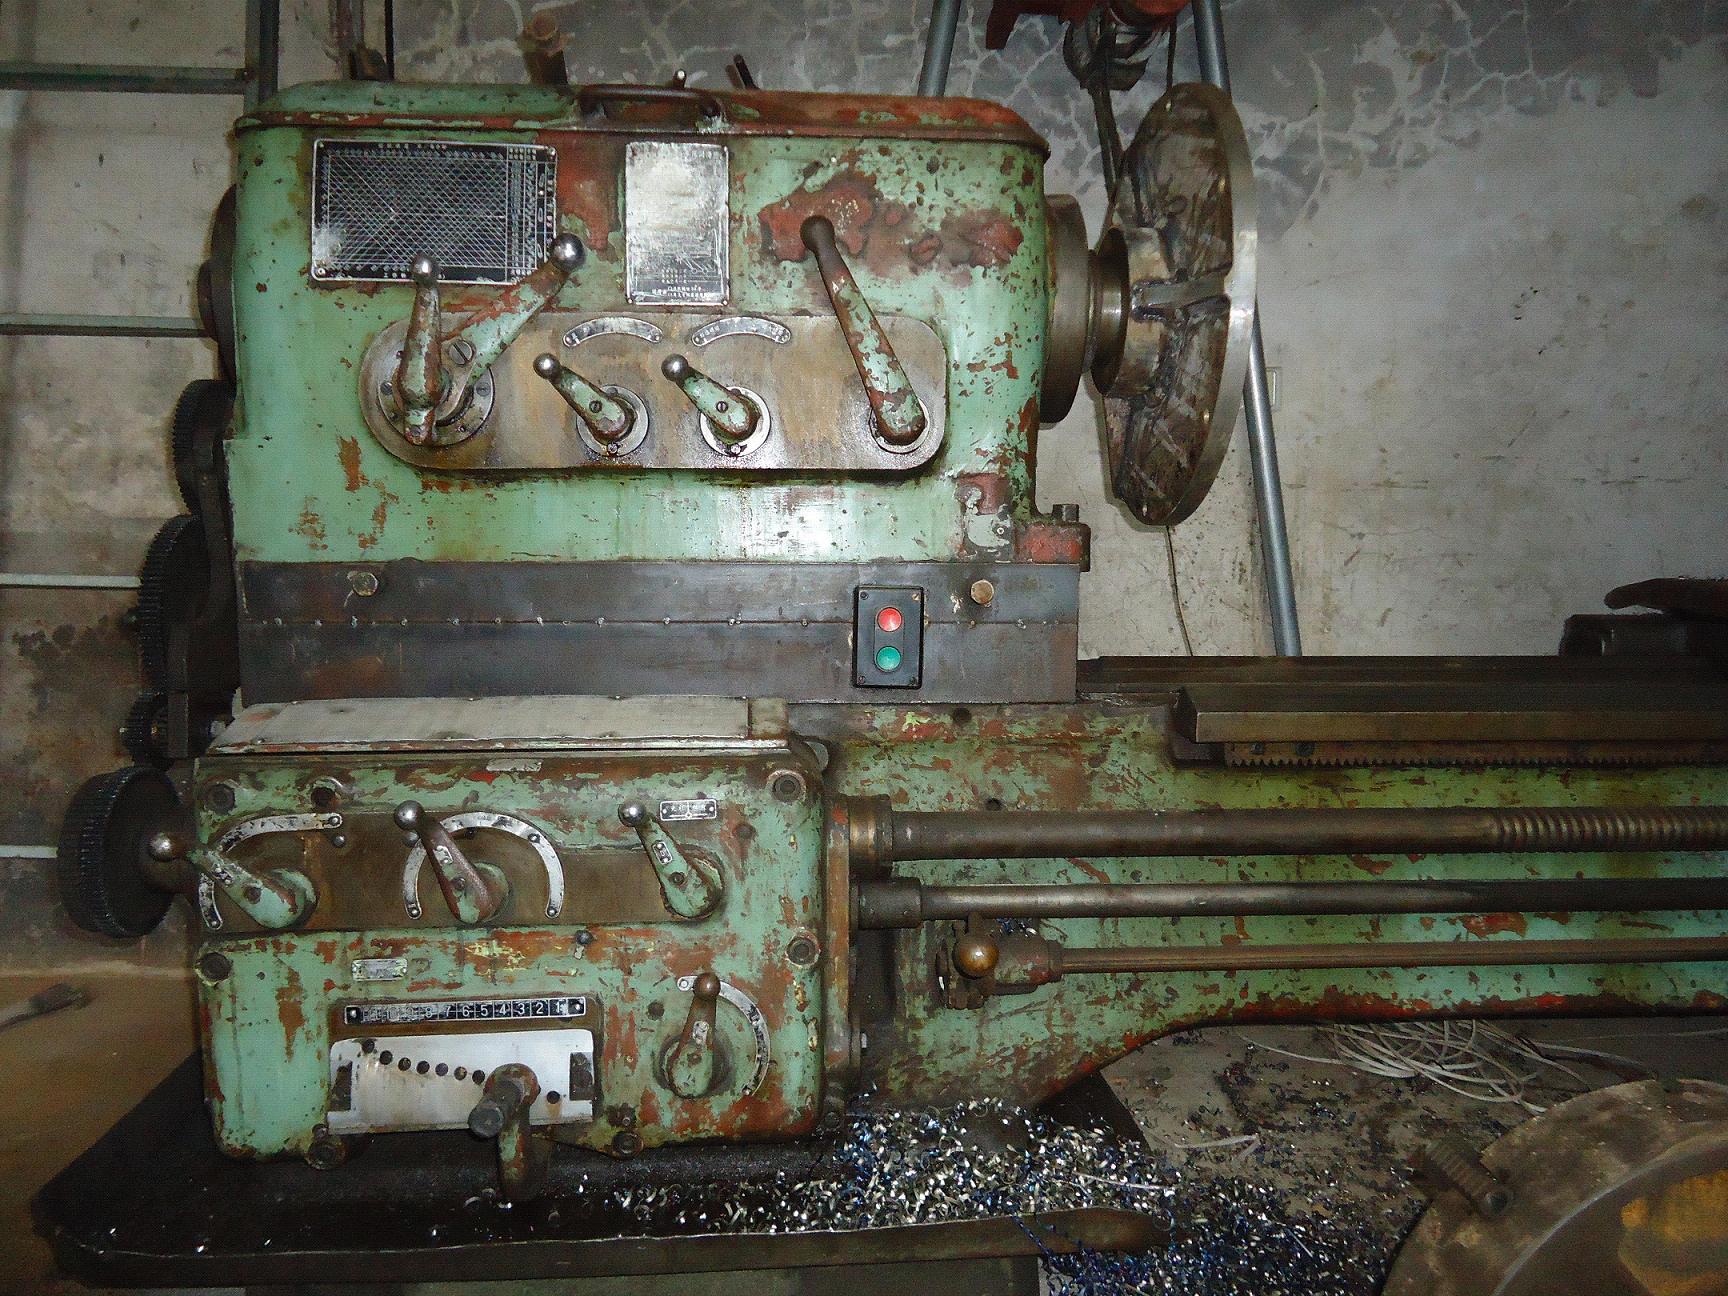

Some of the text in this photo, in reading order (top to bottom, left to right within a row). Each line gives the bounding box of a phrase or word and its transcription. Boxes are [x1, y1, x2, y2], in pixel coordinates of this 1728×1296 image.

[425, 1006, 433, 1018] 8
[445, 1006, 452, 1017] 7
[462, 1005, 470, 1017] 6
[480, 1004, 489, 1017] 5
[499, 1004, 507, 1015] 4
[518, 1003, 525, 1015] 3
[536, 1002, 544, 1014] 2
[555, 1001, 560, 1013] 1
